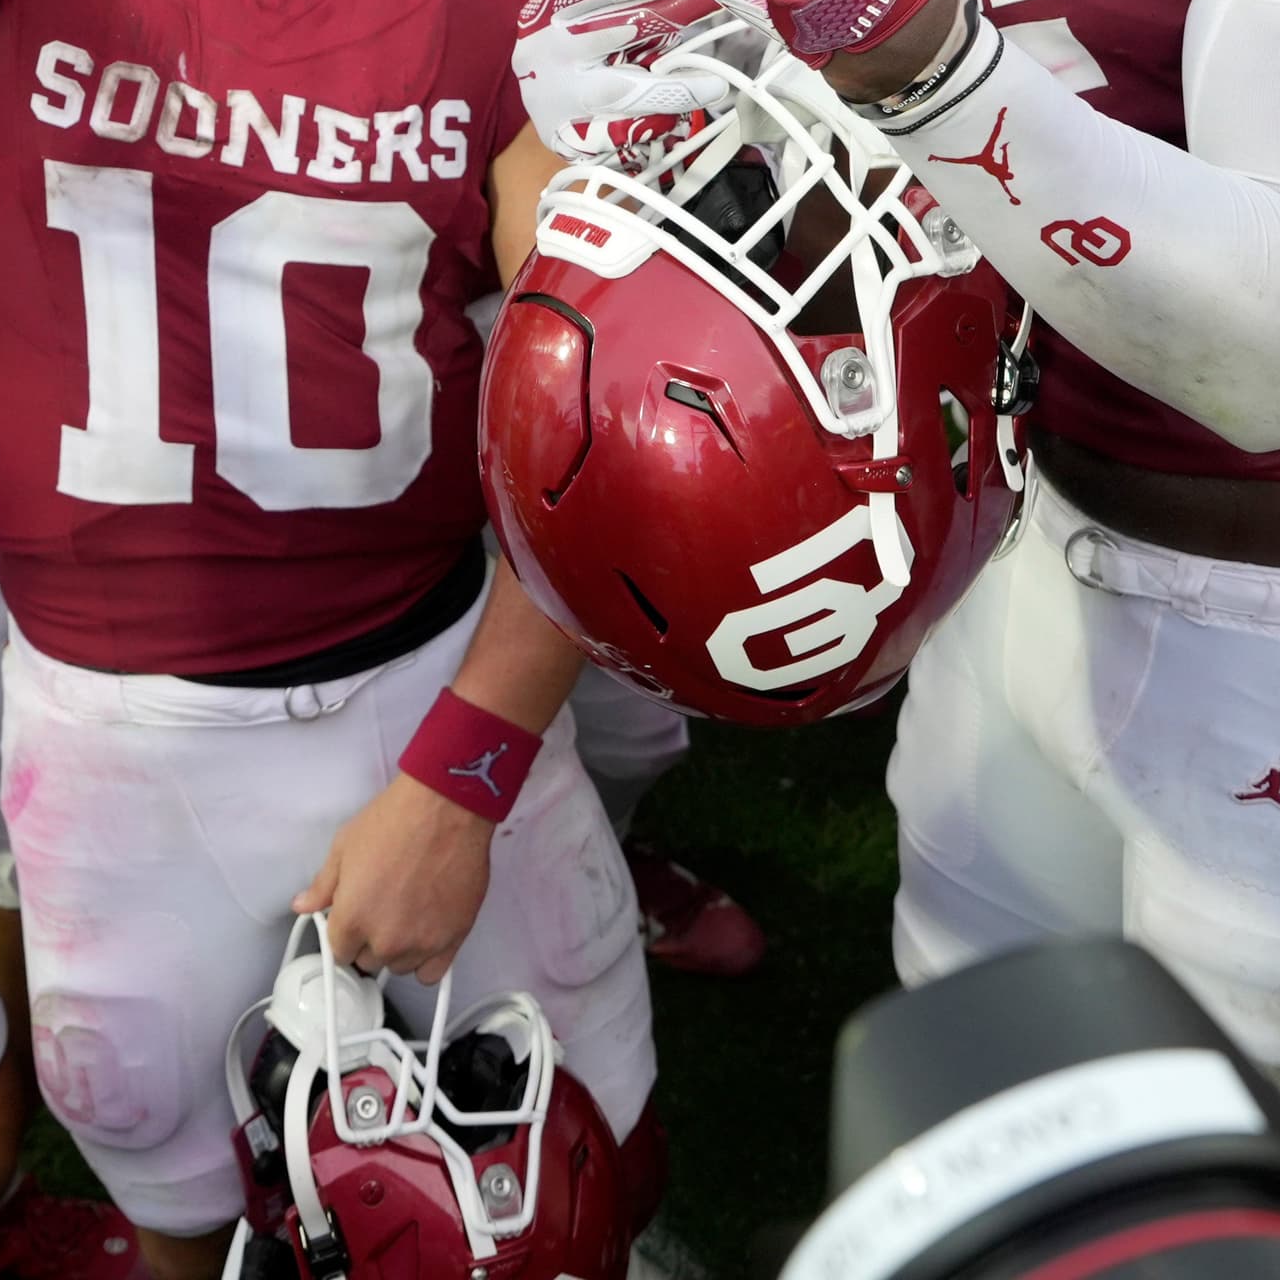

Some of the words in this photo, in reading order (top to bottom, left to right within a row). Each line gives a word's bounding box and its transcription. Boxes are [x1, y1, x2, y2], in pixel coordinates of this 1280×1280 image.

[29, 39, 473, 184] SOONERS
[42, 158, 439, 513] 10
[705, 504, 916, 692] OU
